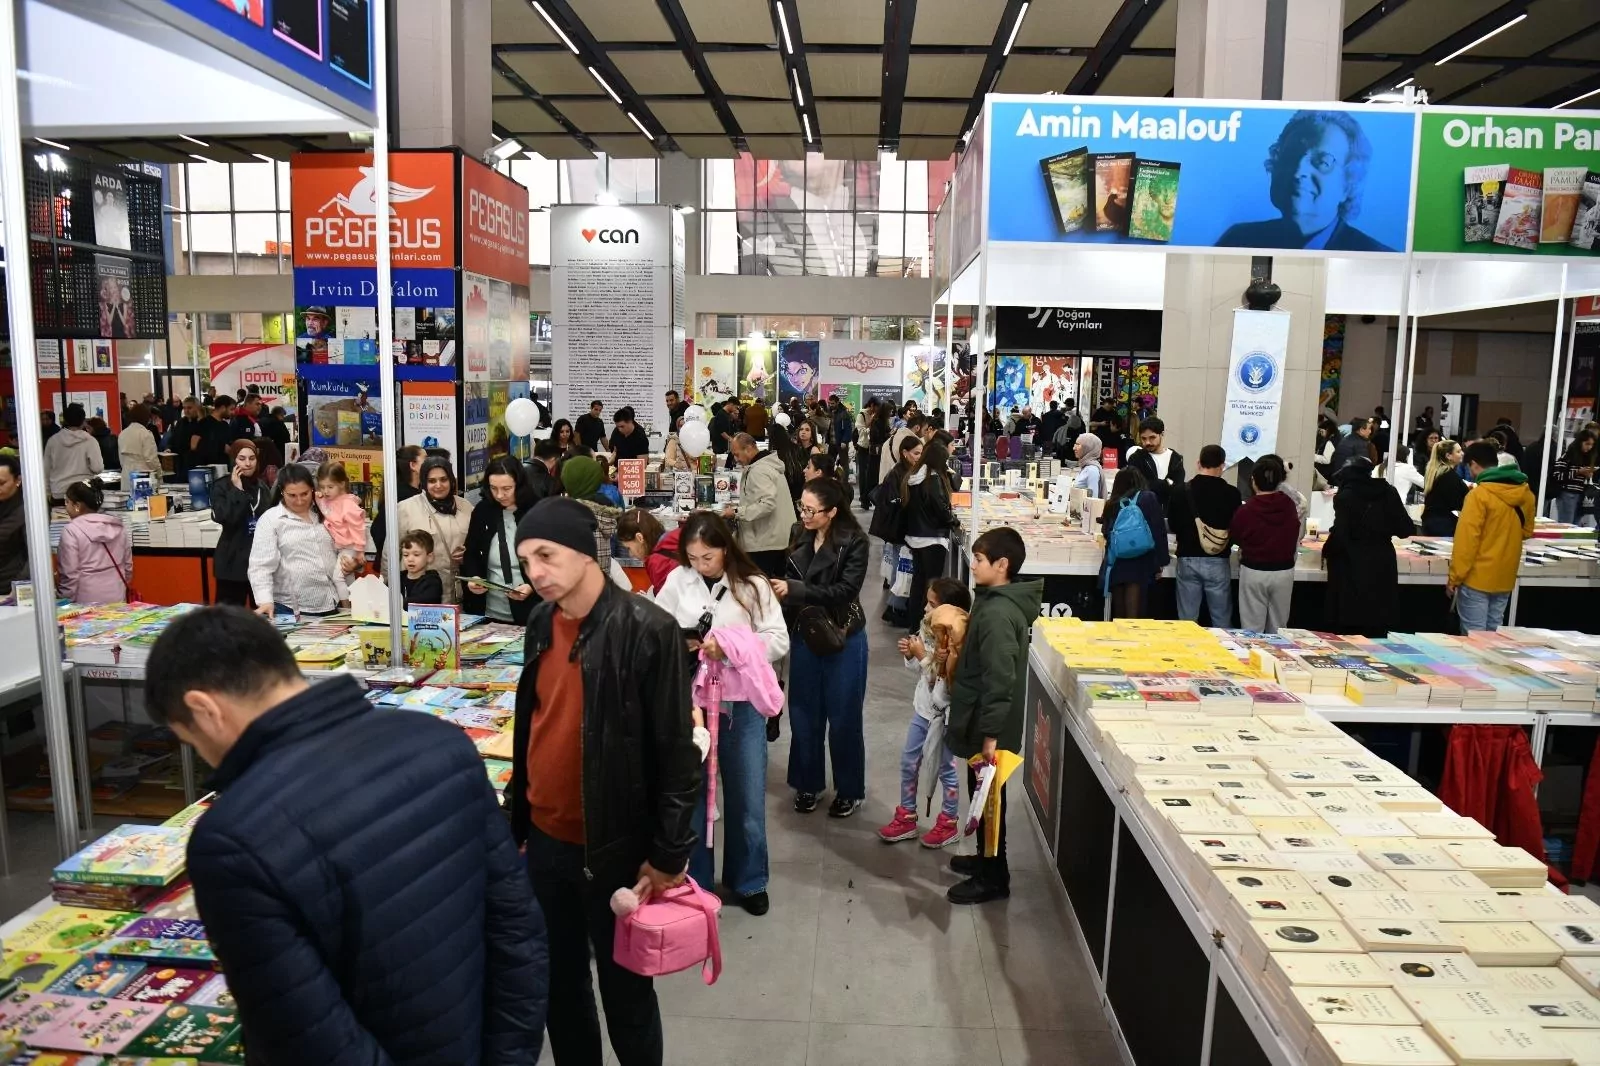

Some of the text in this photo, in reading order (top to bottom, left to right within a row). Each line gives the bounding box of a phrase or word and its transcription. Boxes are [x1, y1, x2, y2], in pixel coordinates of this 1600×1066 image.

[1016, 105, 1242, 142] Amin Maalouf
[1443, 117, 1543, 149] Orhan
[94, 174, 123, 190] ARDA
[470, 188, 525, 246] PEGASUS
[599, 229, 639, 244] can
[311, 280, 353, 296] Irvin
[1056, 308, 1091, 320] Doğan
[1056, 319, 1103, 331] Yayınları
[245, 370, 277, 382] ODTÜ
[310, 380, 349, 393] Kumkurdu
[623, 480, 640, 489] %50
